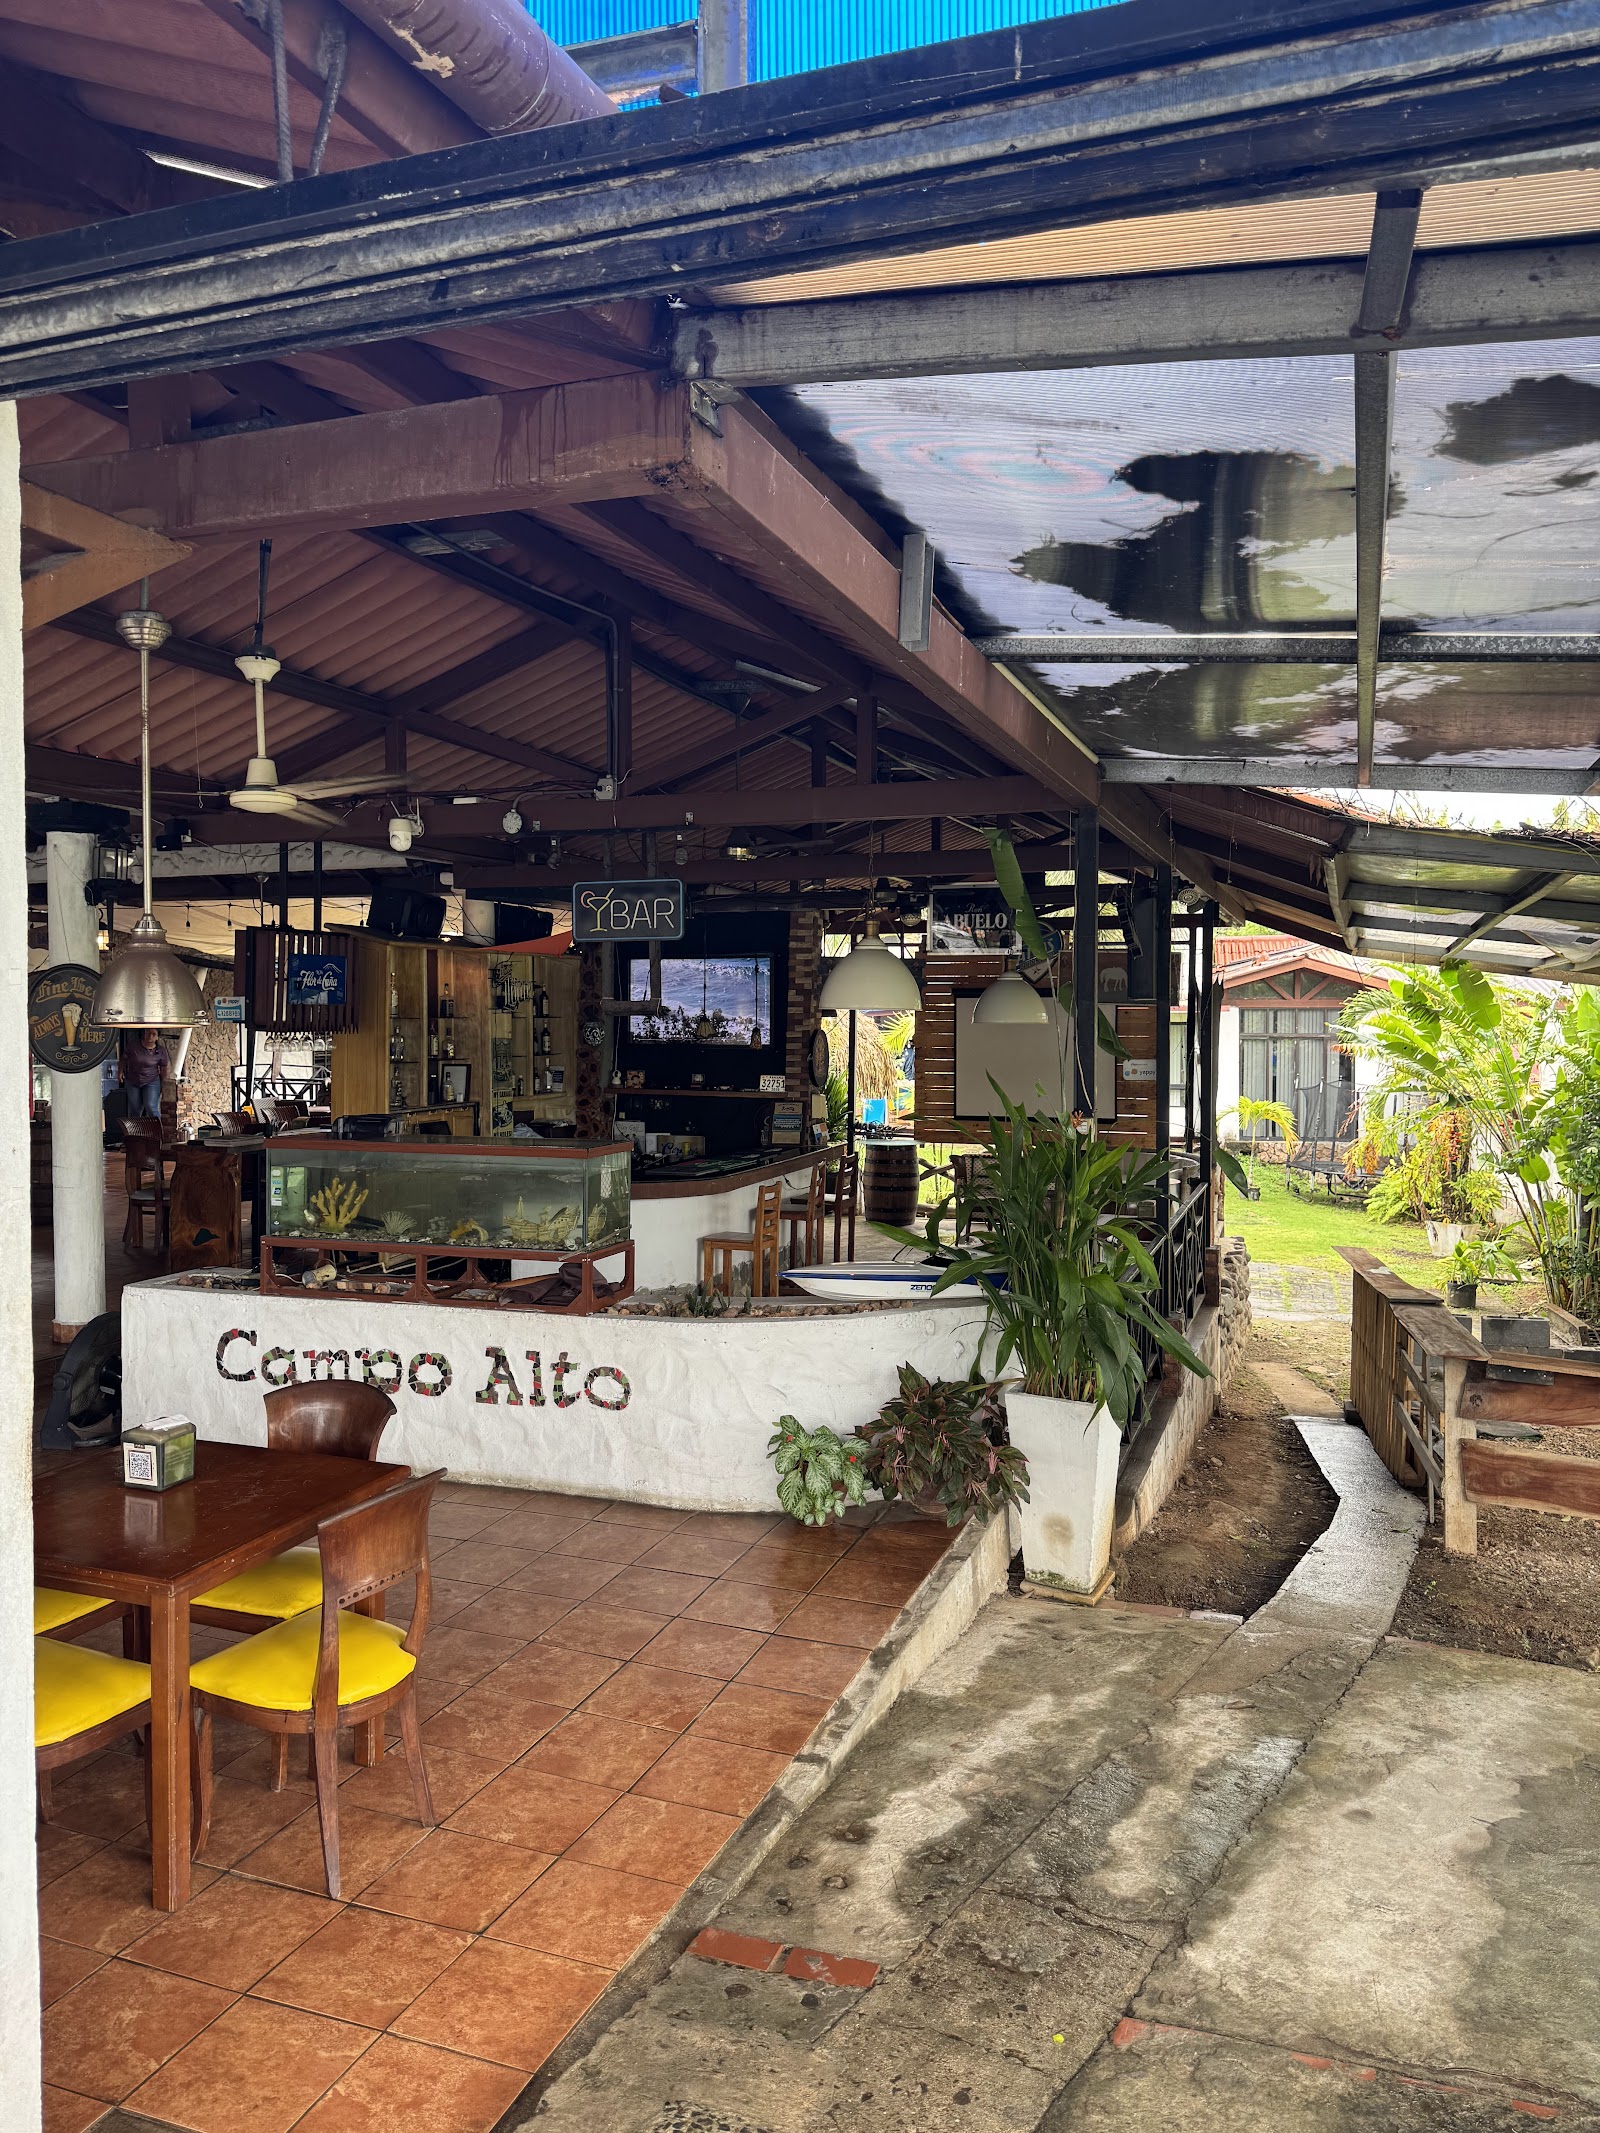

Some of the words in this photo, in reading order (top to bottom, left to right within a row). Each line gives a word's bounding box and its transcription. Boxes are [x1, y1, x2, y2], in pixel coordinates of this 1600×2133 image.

[610, 898, 675, 930] BAR
[944, 912, 1008, 930] ABUELO
[300, 970, 317, 989] Flor
[322, 971, 338, 991] Caña
[34, 1013, 61, 1039] ALWAYS
[79, 1027, 106, 1044] HERE
[761, 1079, 785, 1088] 32751
[215, 1328, 454, 1397] Campo
[475, 1346, 632, 1411] Alto
